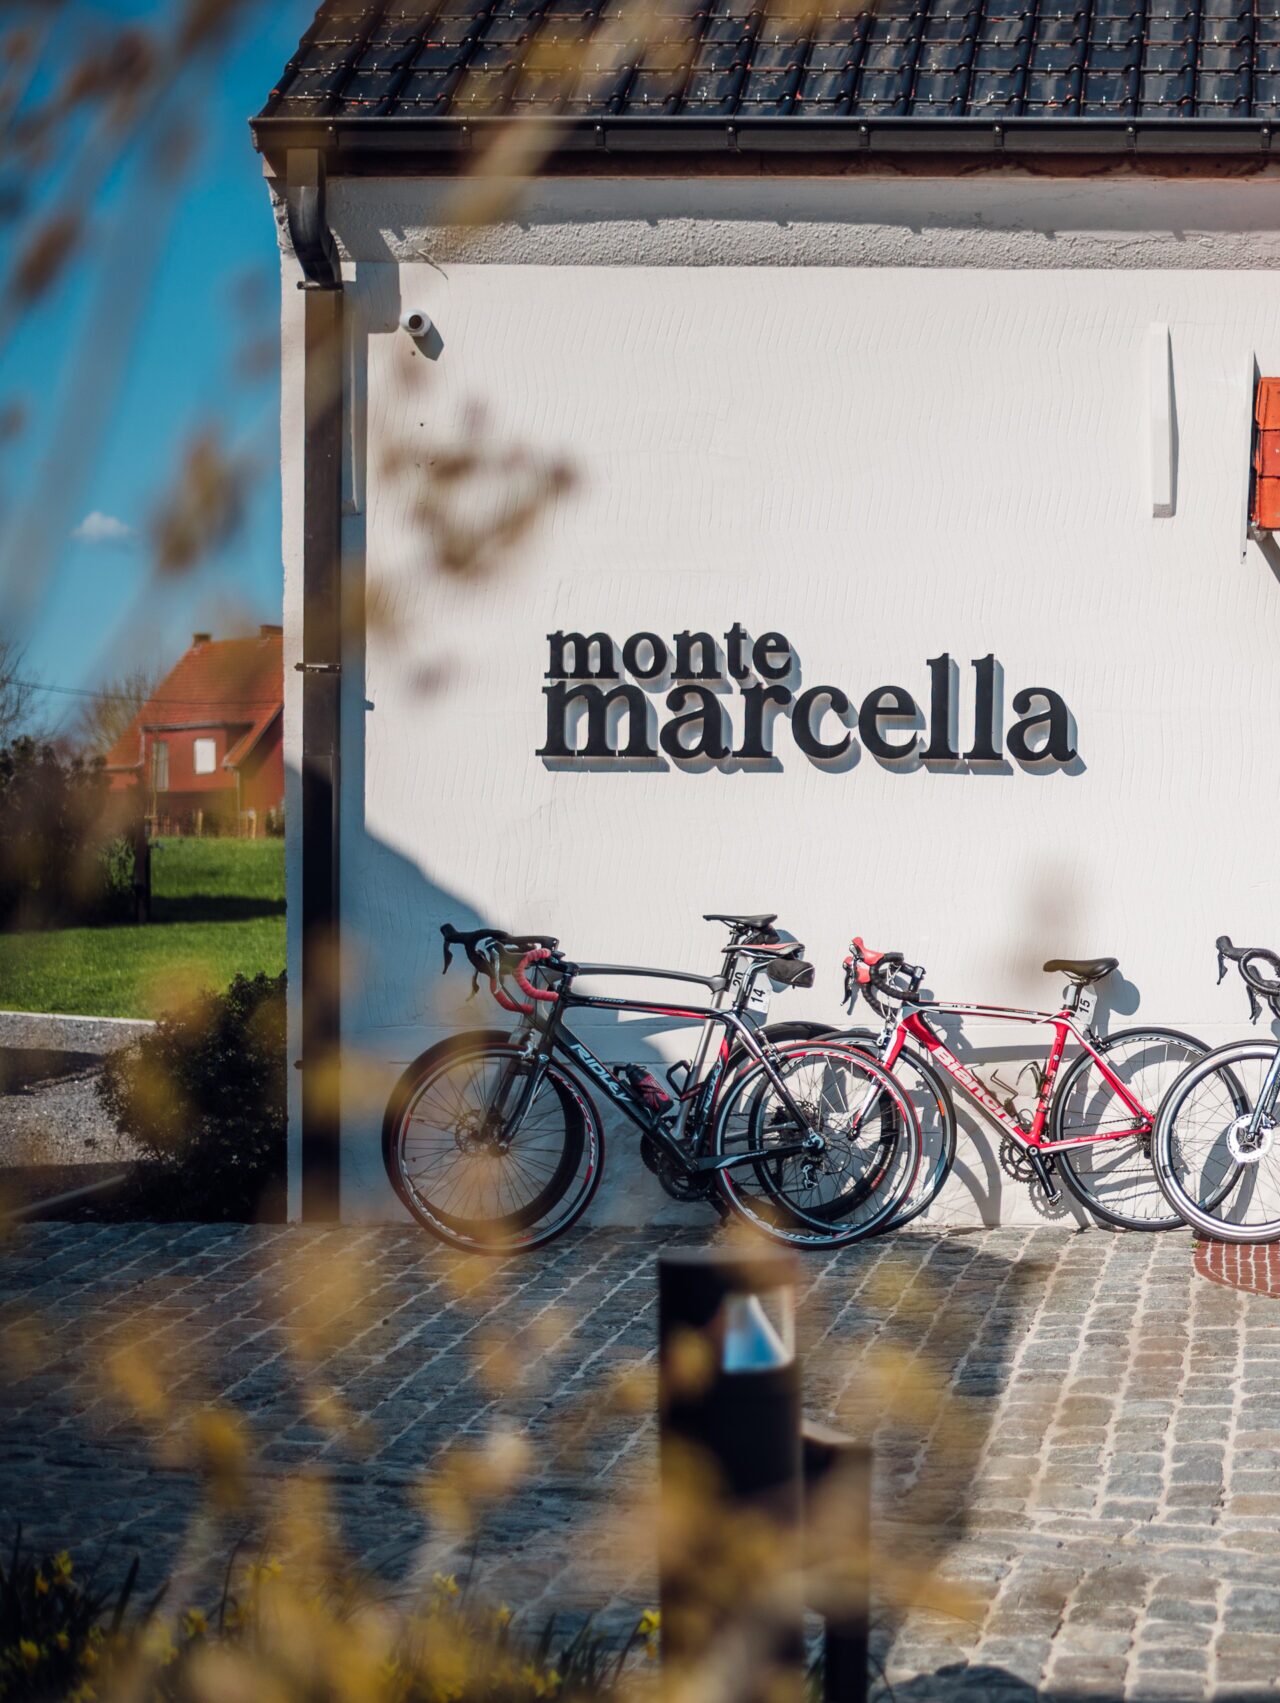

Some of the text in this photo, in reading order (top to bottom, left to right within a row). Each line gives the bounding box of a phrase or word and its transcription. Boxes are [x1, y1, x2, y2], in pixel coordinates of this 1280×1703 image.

[544, 622, 793, 680] monte
[535, 652, 1078, 762] marcella
[733, 972, 744, 987] 20
[751, 988, 766, 1003] 14
[1079, 999, 1091, 1013] 15
[931, 1045, 1020, 1129] Bianchi
